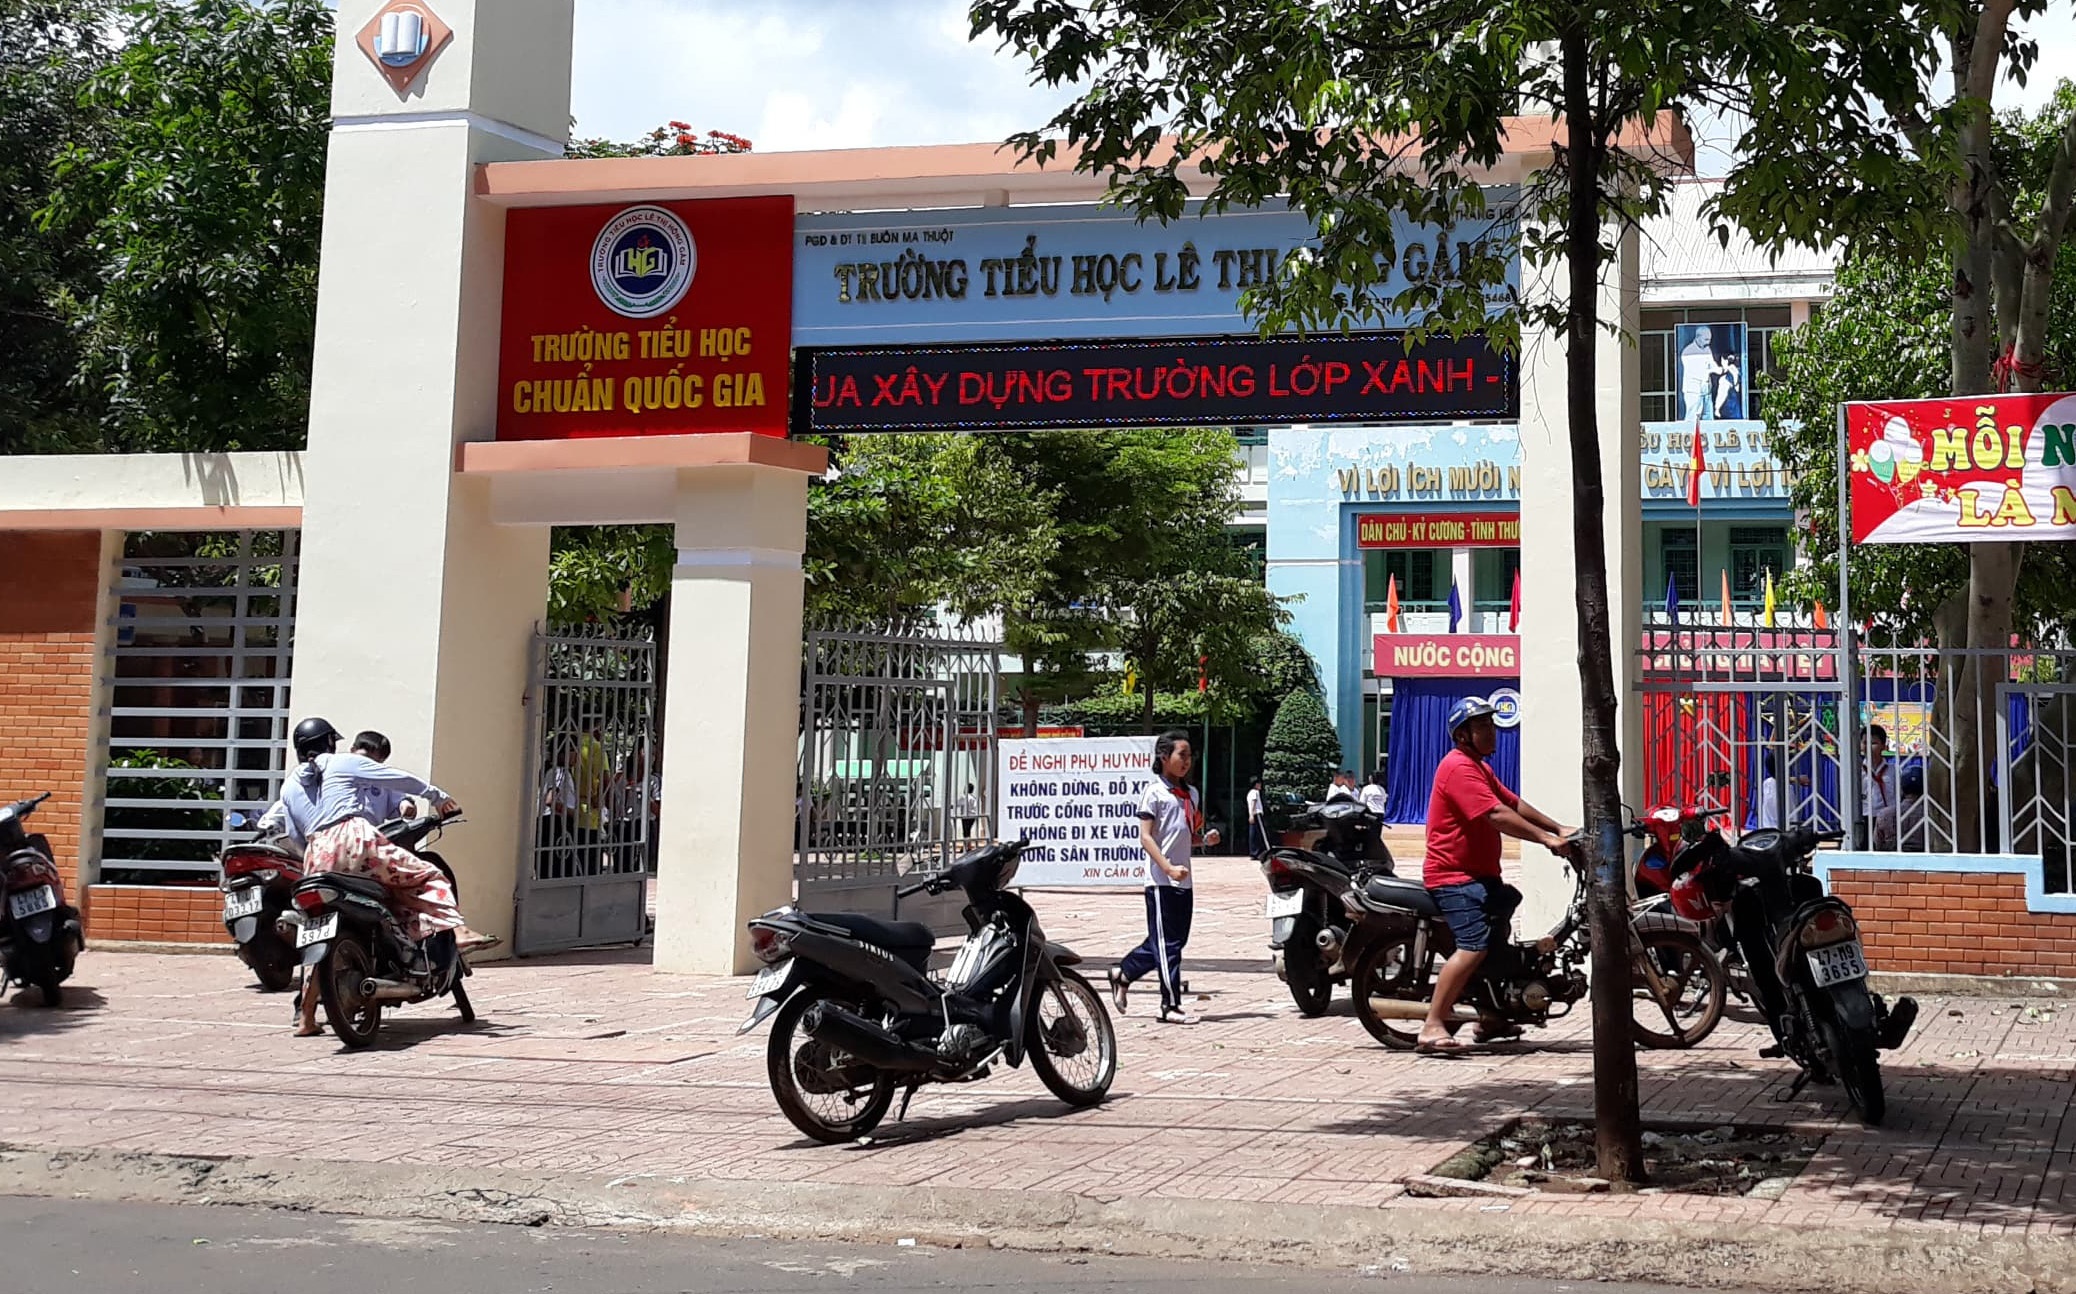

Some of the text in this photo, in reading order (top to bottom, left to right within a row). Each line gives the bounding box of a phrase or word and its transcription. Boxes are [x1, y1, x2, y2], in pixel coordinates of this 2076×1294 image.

[903, 231, 919, 243] MA
[834, 247, 969, 302] TRƯỜNG
[980, 234, 1062, 298] TIỂU
[1071, 252, 1143, 304] HỌC
[1154, 240, 1200, 291] LÊ
[531, 316, 751, 363] TRƯỜNG TIỂU HỌC
[513, 362, 766, 414] CHUẨN QUỐC GIA
[871, 365, 949, 407] XÂY
[959, 370, 1073, 410] DỰNG
[1082, 358, 1255, 402] TRƯỜNG
[1269, 354, 1350, 397] LỚP
[1360, 358, 1474, 396] XANH
[1714, 428, 1739, 448] LÊ
[1930, 405, 2026, 471] MỖI
[1338, 463, 1359, 492] VÌ
[1366, 463, 1399, 498] LỢI
[1407, 461, 1440, 491] ÍCH
[1450, 459, 1500, 491] MƯỜI
[1708, 457, 1730, 488] VÌ
[1738, 457, 1771, 493] LỢI
[1957, 479, 2036, 527] LÀ
[1361, 519, 1383, 542] DÂN
[1386, 516, 1406, 541] CHỦ
[1429, 520, 1464, 541] CƯƠNG
[1471, 518, 1495, 540] TÌNH
[1394, 641, 1451, 667] NƯỚC
[1456, 643, 1515, 673] CỘNG
[1033, 754, 1066, 772] NGHỊ
[1071, 754, 1097, 771] PHỤ
[1102, 753, 1150, 768] HUYNH
[1010, 780, 1057, 797] KHÔNG
[1062, 778, 1104, 798] DỪNG,
[1109, 776, 1127, 795] ĐỖ
[1008, 801, 1050, 819] TRƯỚC
[1055, 799, 1092, 819] CỔNG
[1020, 822, 1139, 840] KHÔNG ĐI XE VÀO
[1061, 845, 1089, 862] SÂN
[1083, 867, 1101, 878] XIN
[1104, 864, 1129, 878] CẢM
[1822, 960, 1860, 981] 3655
